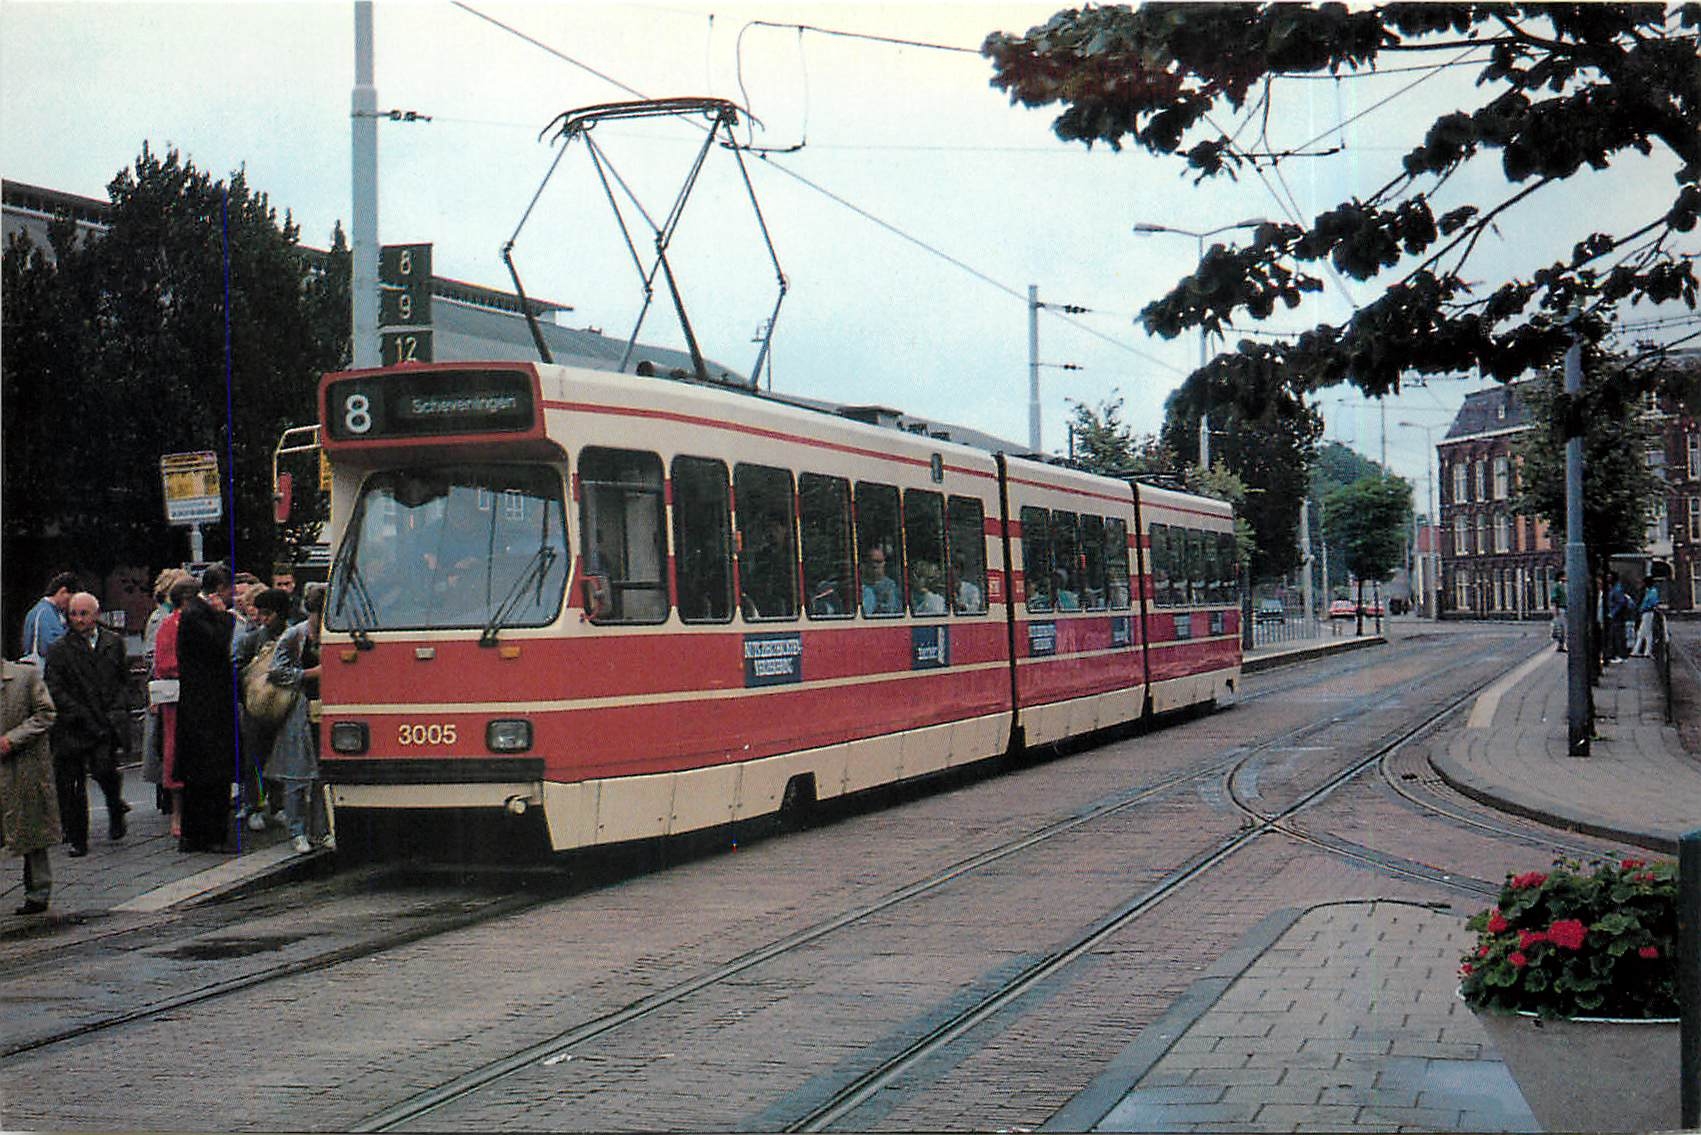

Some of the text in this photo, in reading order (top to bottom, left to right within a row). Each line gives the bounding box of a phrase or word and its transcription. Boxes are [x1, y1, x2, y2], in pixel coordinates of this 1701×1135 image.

[400, 250, 411, 275] 8
[400, 294, 411, 319] 9
[396, 337, 417, 362] 12
[345, 394, 372, 434] 8
[398, 724, 457, 745] 3005
